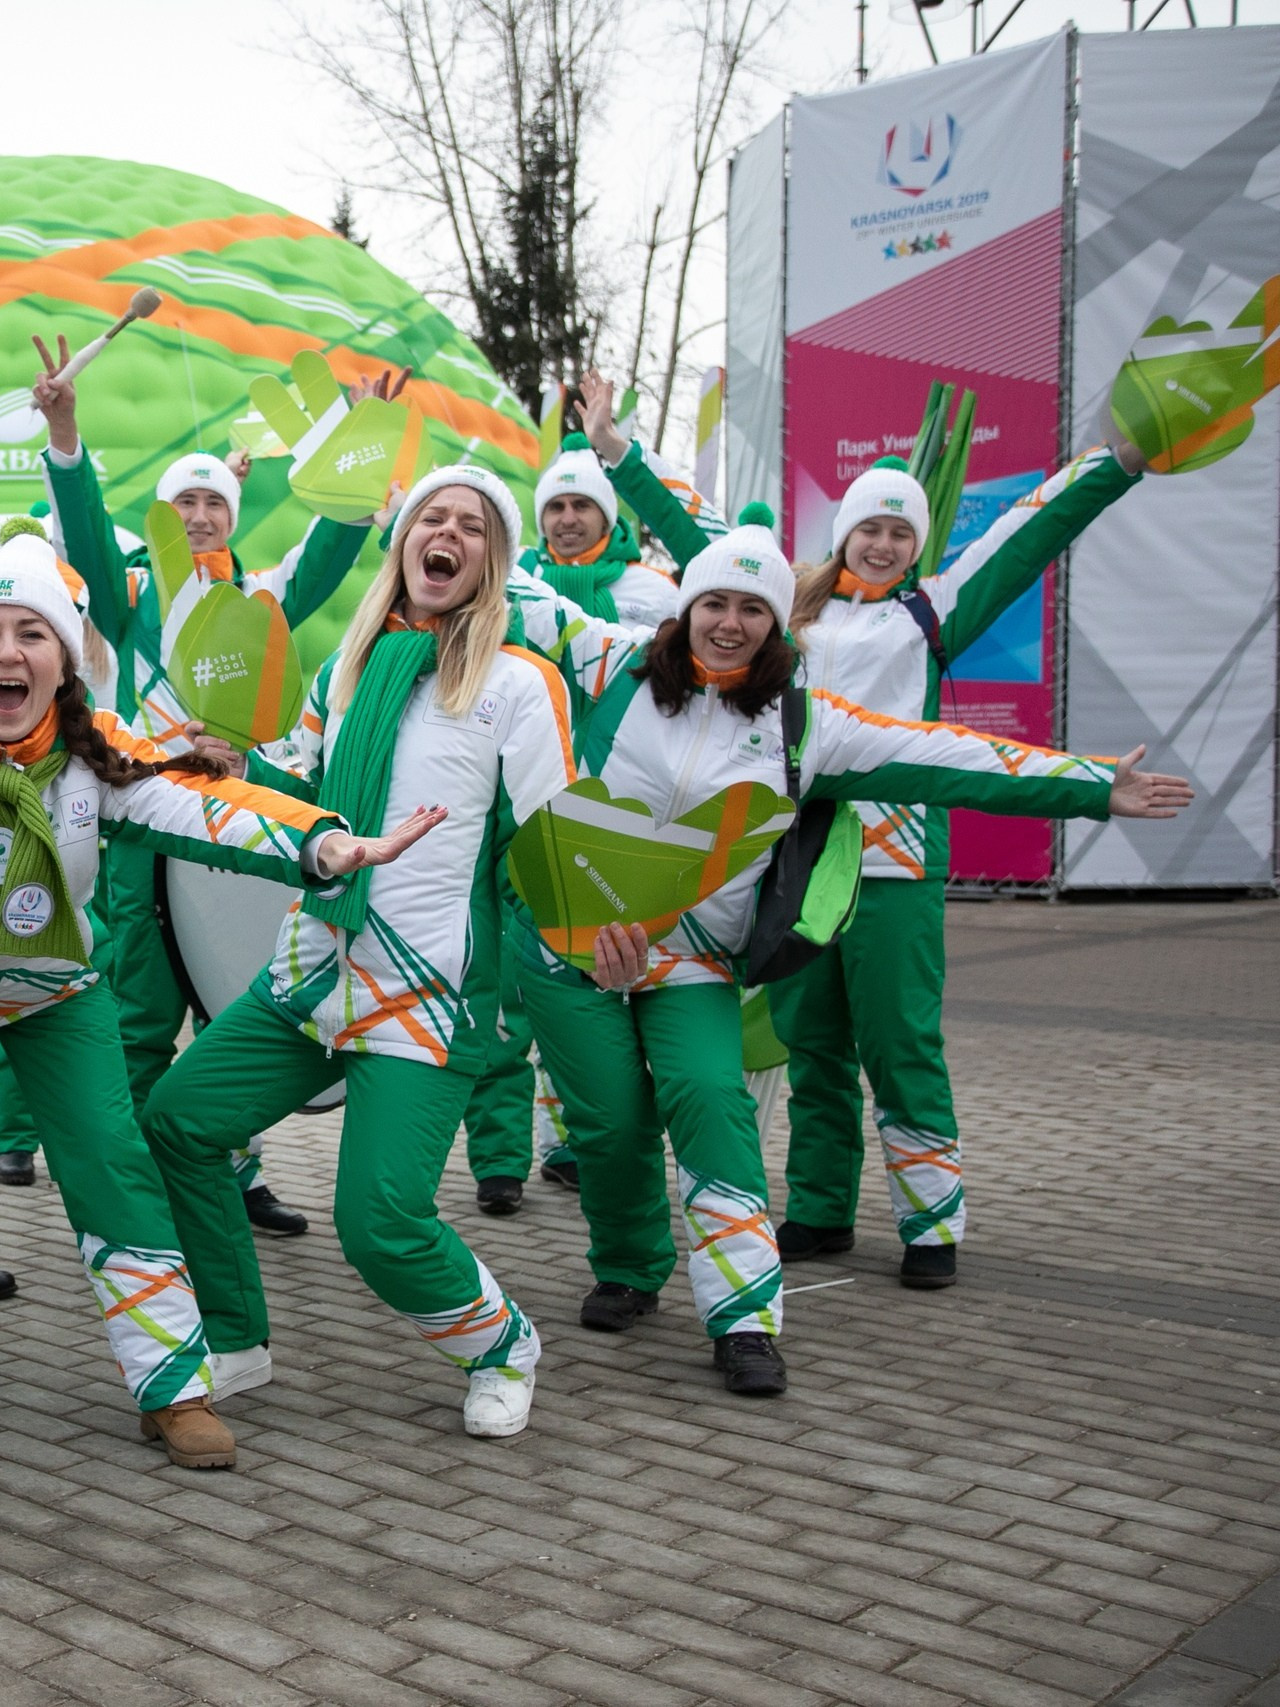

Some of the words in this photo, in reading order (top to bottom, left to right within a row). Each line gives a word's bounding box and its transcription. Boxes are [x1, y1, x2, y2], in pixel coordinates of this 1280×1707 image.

[850, 199, 953, 229] KRASNOYARSK
[957, 191, 990, 208] 2019
[836, 438, 879, 459] Парк
[213, 652, 242, 664] sber
[216, 659, 246, 673] cool
[218, 669, 248, 683] games
[586, 866, 628, 913] SBERBANK
